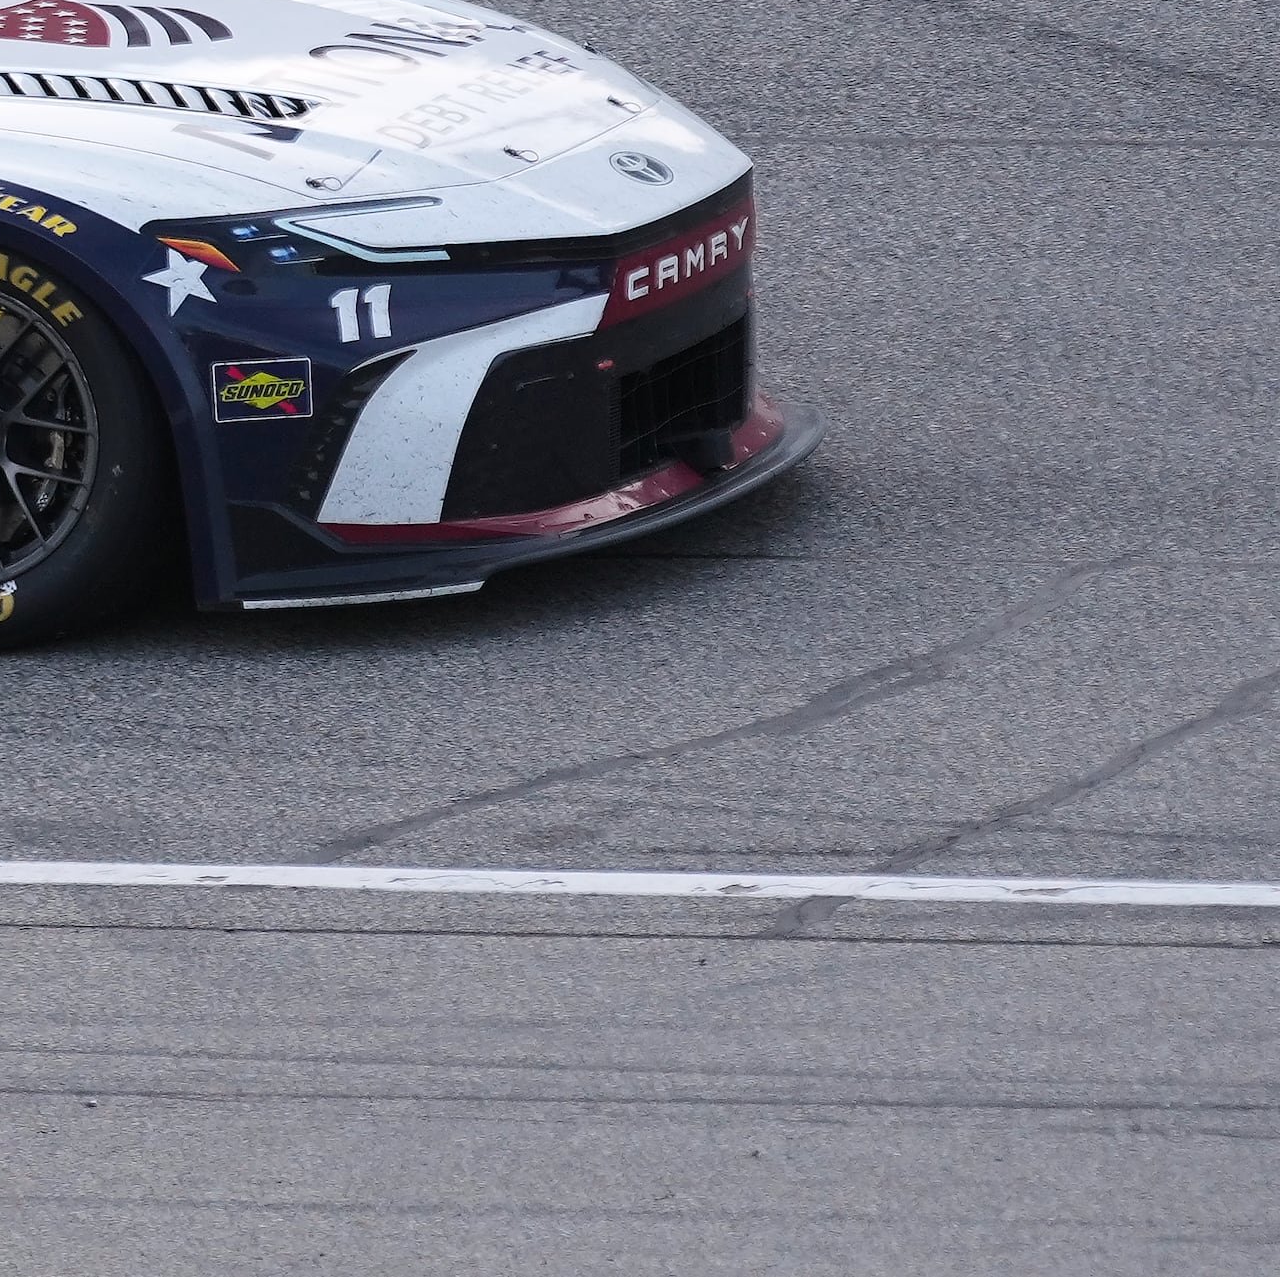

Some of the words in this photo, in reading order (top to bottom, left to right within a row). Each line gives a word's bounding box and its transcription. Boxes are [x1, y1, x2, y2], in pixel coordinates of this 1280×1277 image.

[626, 216, 753, 301] CAMRY
[331, 284, 392, 343] 11
[224, 381, 303, 401] SUNOCO
